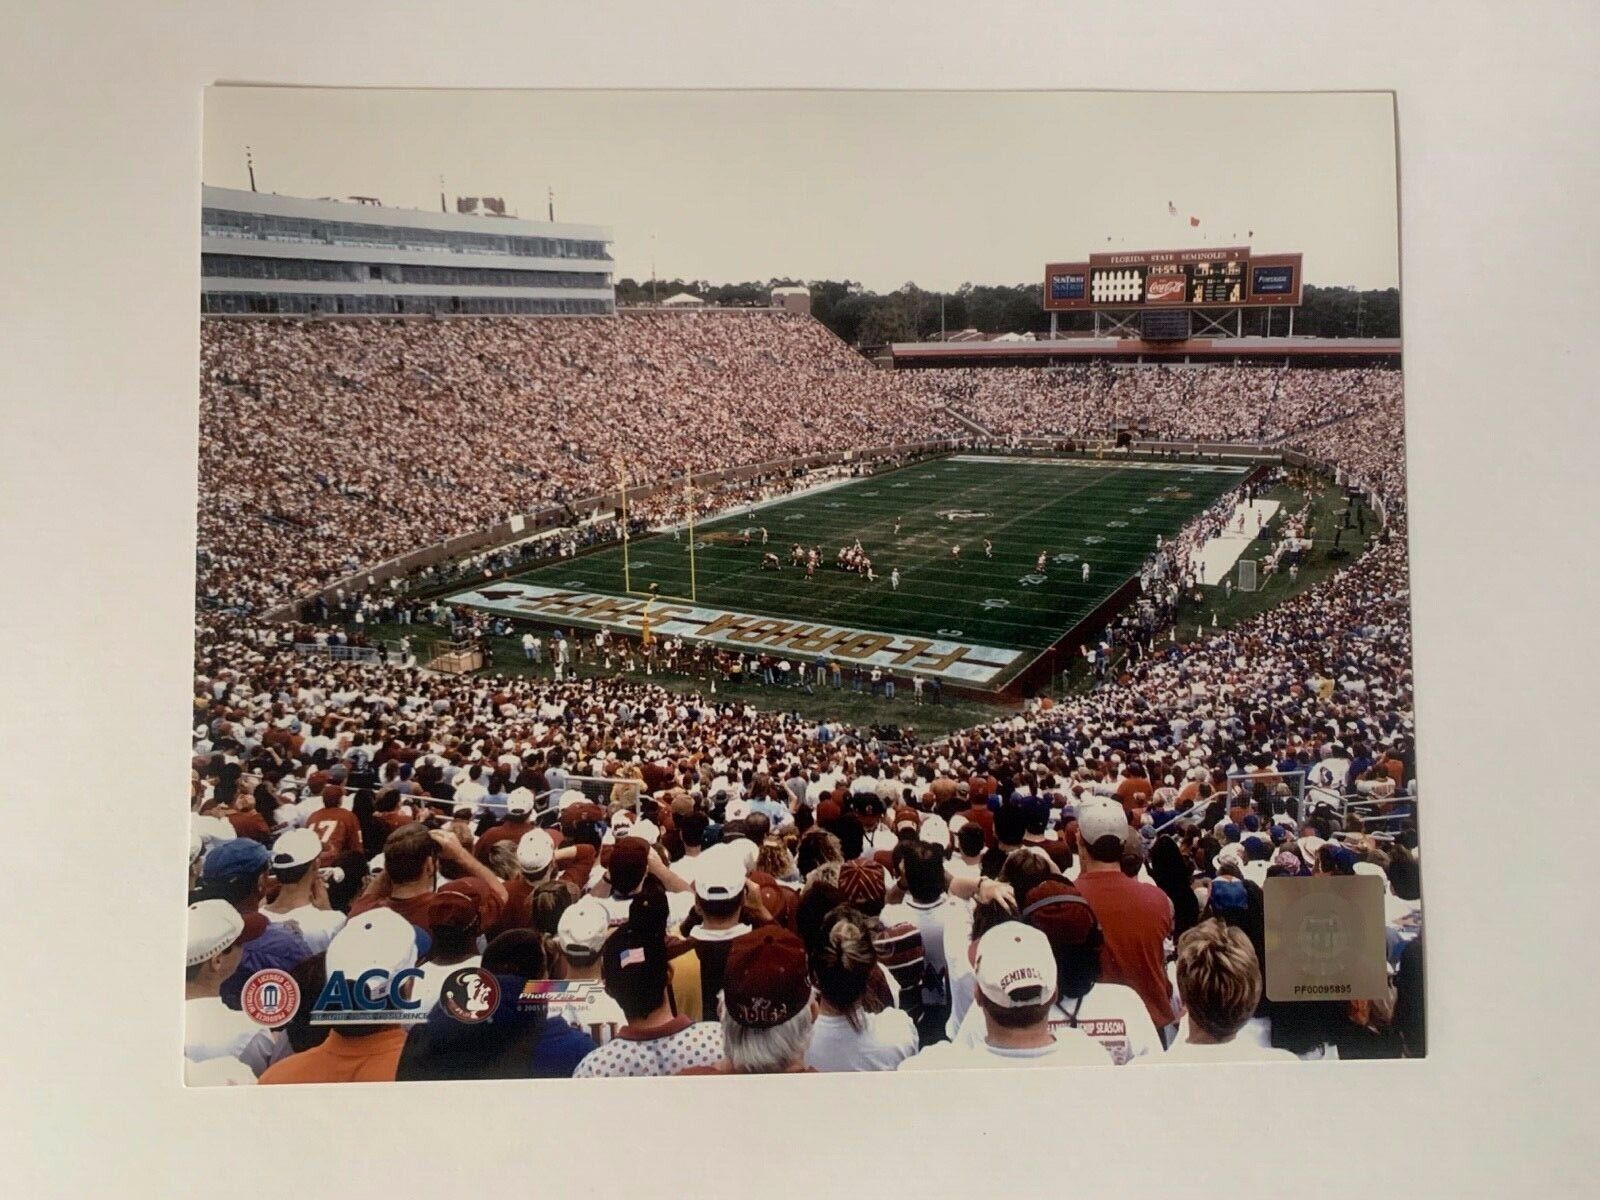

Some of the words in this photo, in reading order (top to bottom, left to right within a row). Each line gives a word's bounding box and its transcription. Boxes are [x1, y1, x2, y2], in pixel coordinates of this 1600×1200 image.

[1111, 256, 1145, 264] FLORIDA
[1151, 254, 1174, 262] STATE
[1181, 252, 1227, 260] SEMINOLES
[694, 613, 971, 671] FLORIDA
[313, 968, 425, 1010] ACC
[1096, 1021, 1124, 1034] SEASON
